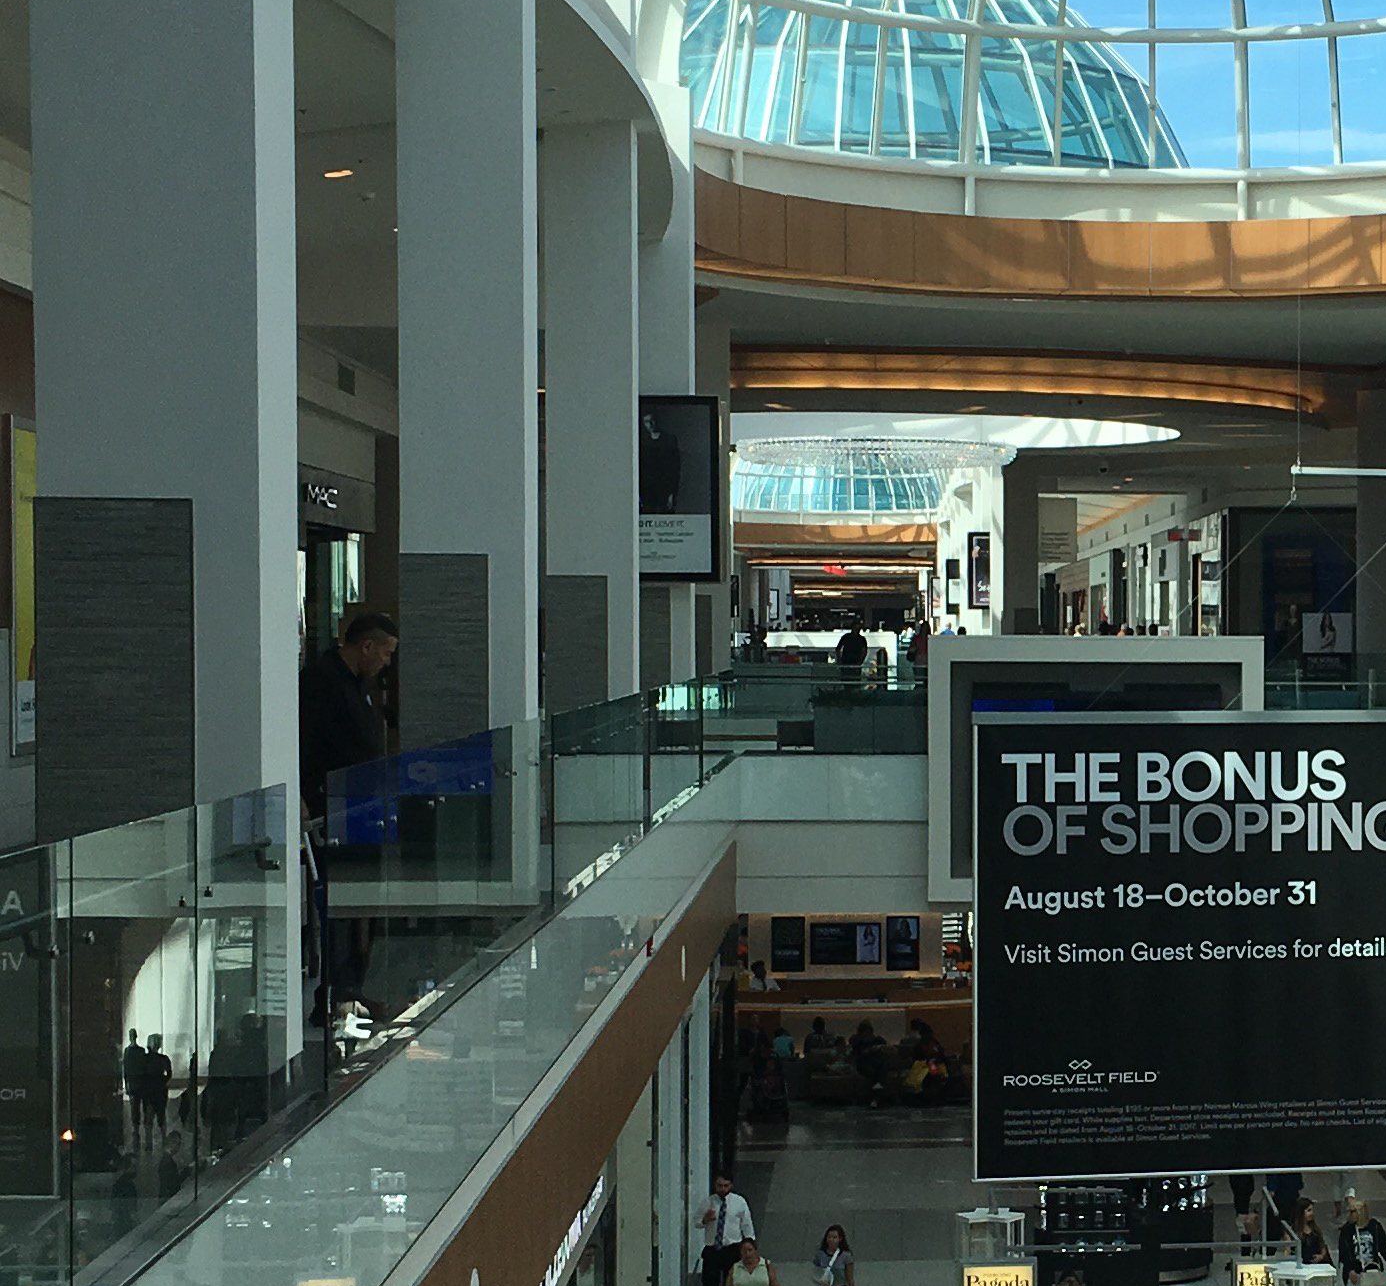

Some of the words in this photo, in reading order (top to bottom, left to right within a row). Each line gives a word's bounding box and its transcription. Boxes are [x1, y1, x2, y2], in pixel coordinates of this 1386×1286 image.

[1002, 752, 1121, 804] THE
[1138, 750, 1346, 803] BONUS
[1003, 804, 1086, 856] OF
[1005, 885, 1105, 915] August
[1287, 881, 1317, 906] 31
[1005, 942, 1051, 964] Visit
[1057, 941, 1123, 963] Simon
[1131, 941, 1194, 962] Guest
[1200, 939, 1287, 961] Services
[1293, 938, 1322, 959] for
[1003, 1072, 1106, 1087] ROOSEVELT
